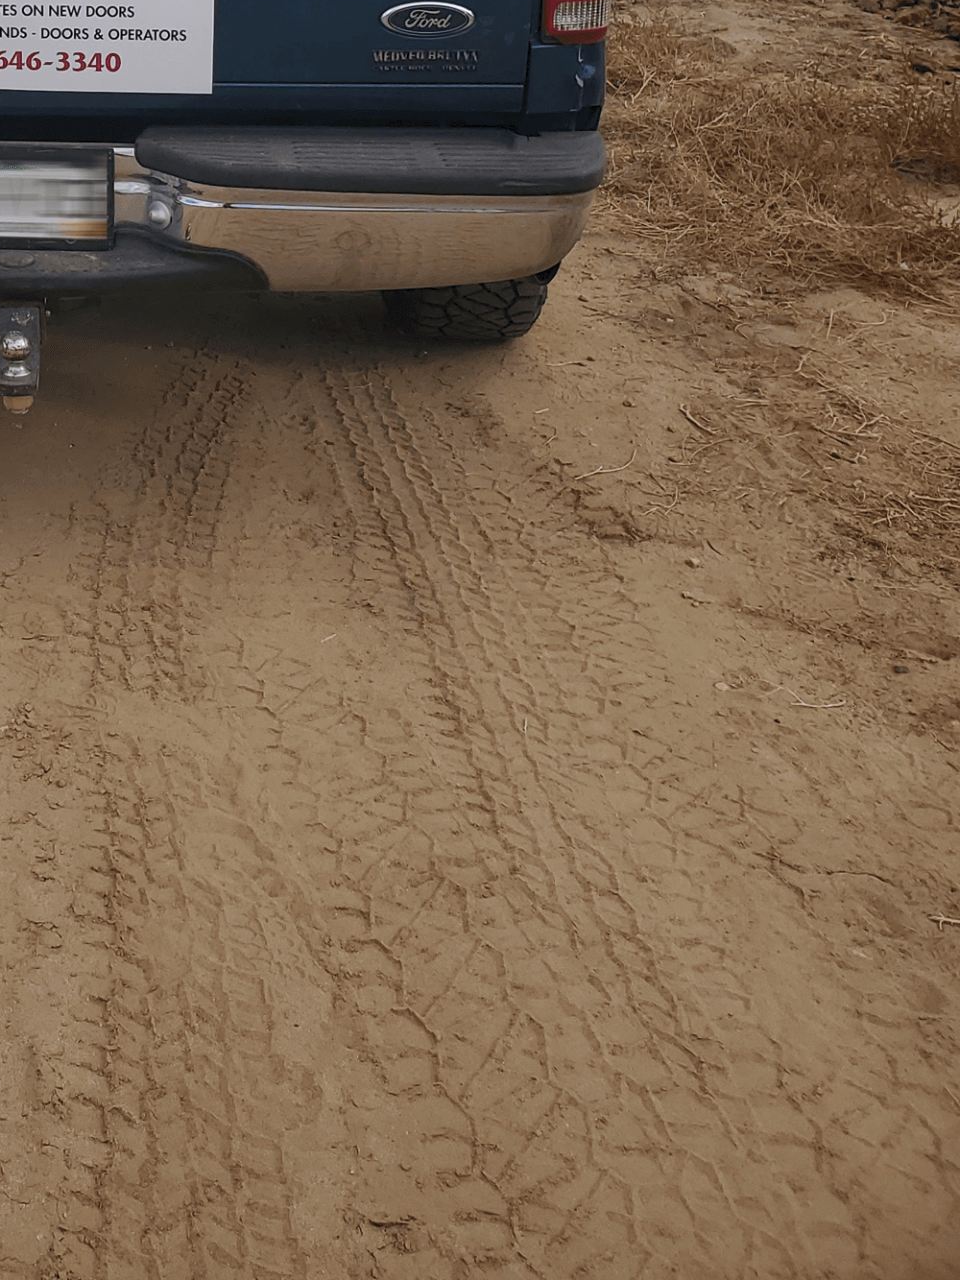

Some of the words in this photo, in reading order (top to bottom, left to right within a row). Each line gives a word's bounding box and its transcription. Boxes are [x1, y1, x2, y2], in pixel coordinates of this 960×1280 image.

[21, 5, 44, 17] ON
[48, 5, 82, 17] NEW
[86, 6, 135, 18] DOORS
[404, 9, 452, 29] Ford
[40, 27, 89, 40] DOORS
[93, 28, 104, 40] &
[108, 28, 187, 41] OPERATORS
